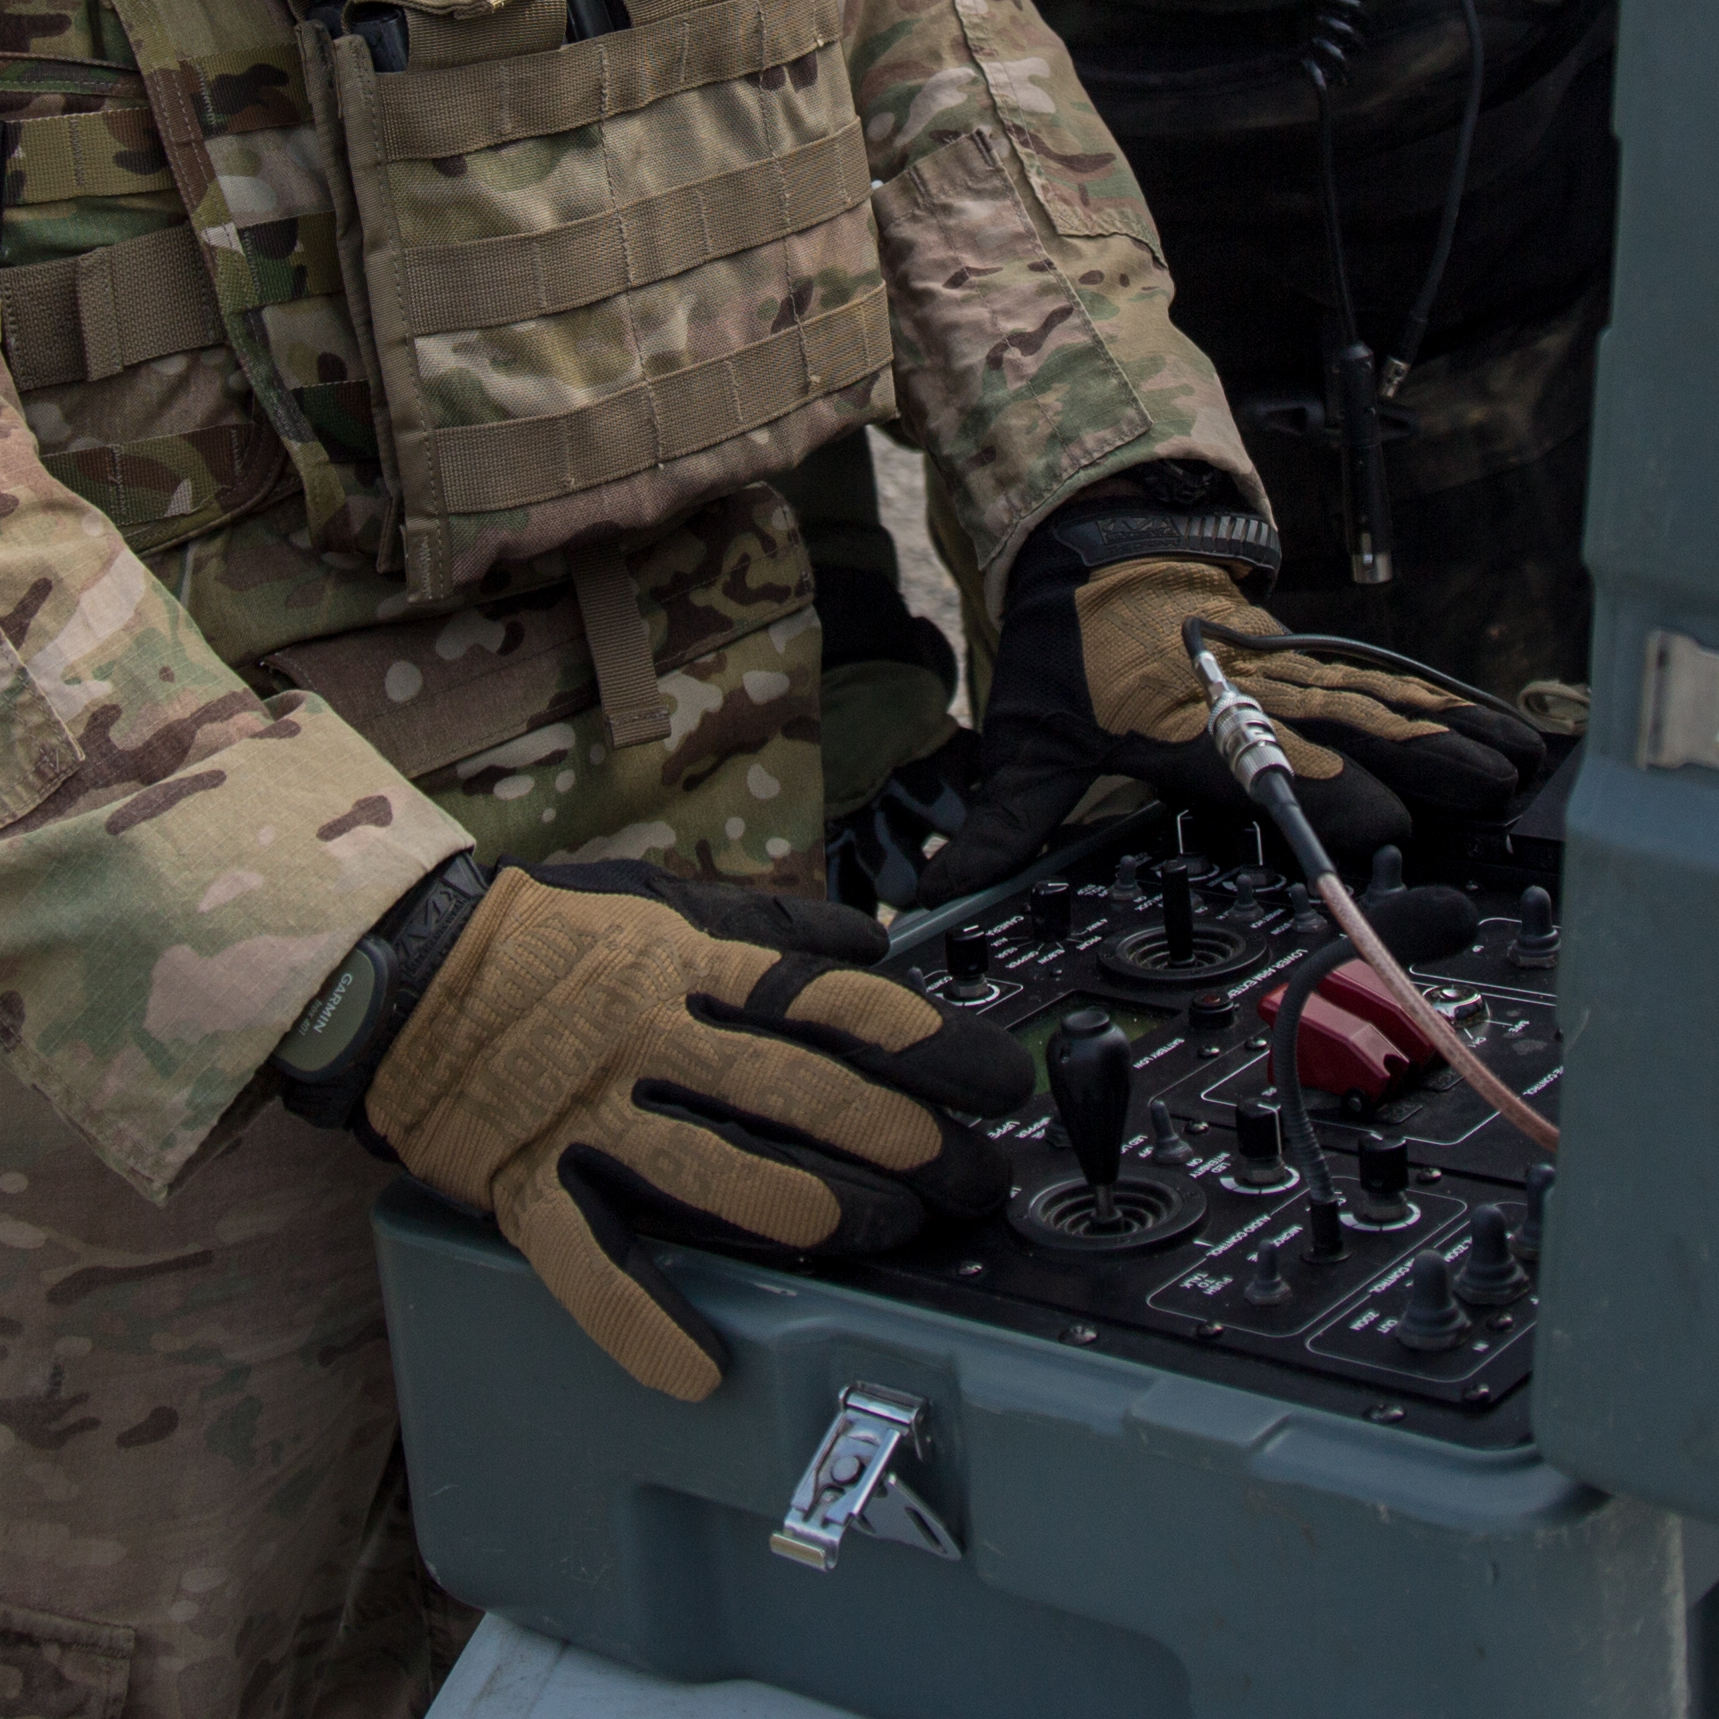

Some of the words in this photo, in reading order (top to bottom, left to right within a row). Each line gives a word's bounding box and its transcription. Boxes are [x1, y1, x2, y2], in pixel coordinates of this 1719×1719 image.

[985, 916, 1024, 935] CAMERA
[1272, 949, 1308, 968] LOWER
[1252, 968, 1276, 981] ARM
[313, 972, 353, 1033] GARMIN
[298, 1018, 312, 1037] 401
[1151, 1039, 1184, 1058] BATTERY
[1134, 1057, 1153, 1068] LOW
[1523, 1074, 1557, 1095] CONTROL
[988, 1121, 1020, 1138] UPPE
[1129, 1135, 1147, 1145] LED
[1187, 1158, 1203, 1166] ON
[1190, 1153, 1230, 1178] INTENSITY
[1211, 1162, 1230, 1173] LED
[1243, 1215, 1270, 1233] AUDIO
[1206, 1231, 1247, 1256] CONTROL
[1180, 1273, 1208, 1288] TALK
[1197, 1279, 1215, 1288] TO
[1204, 1277, 1232, 1295] PUSH
[1369, 1267, 1409, 1292] CONTROL
[1350, 1311, 1379, 1330] ZOOM
[1378, 1319, 1398, 1333] OUT
